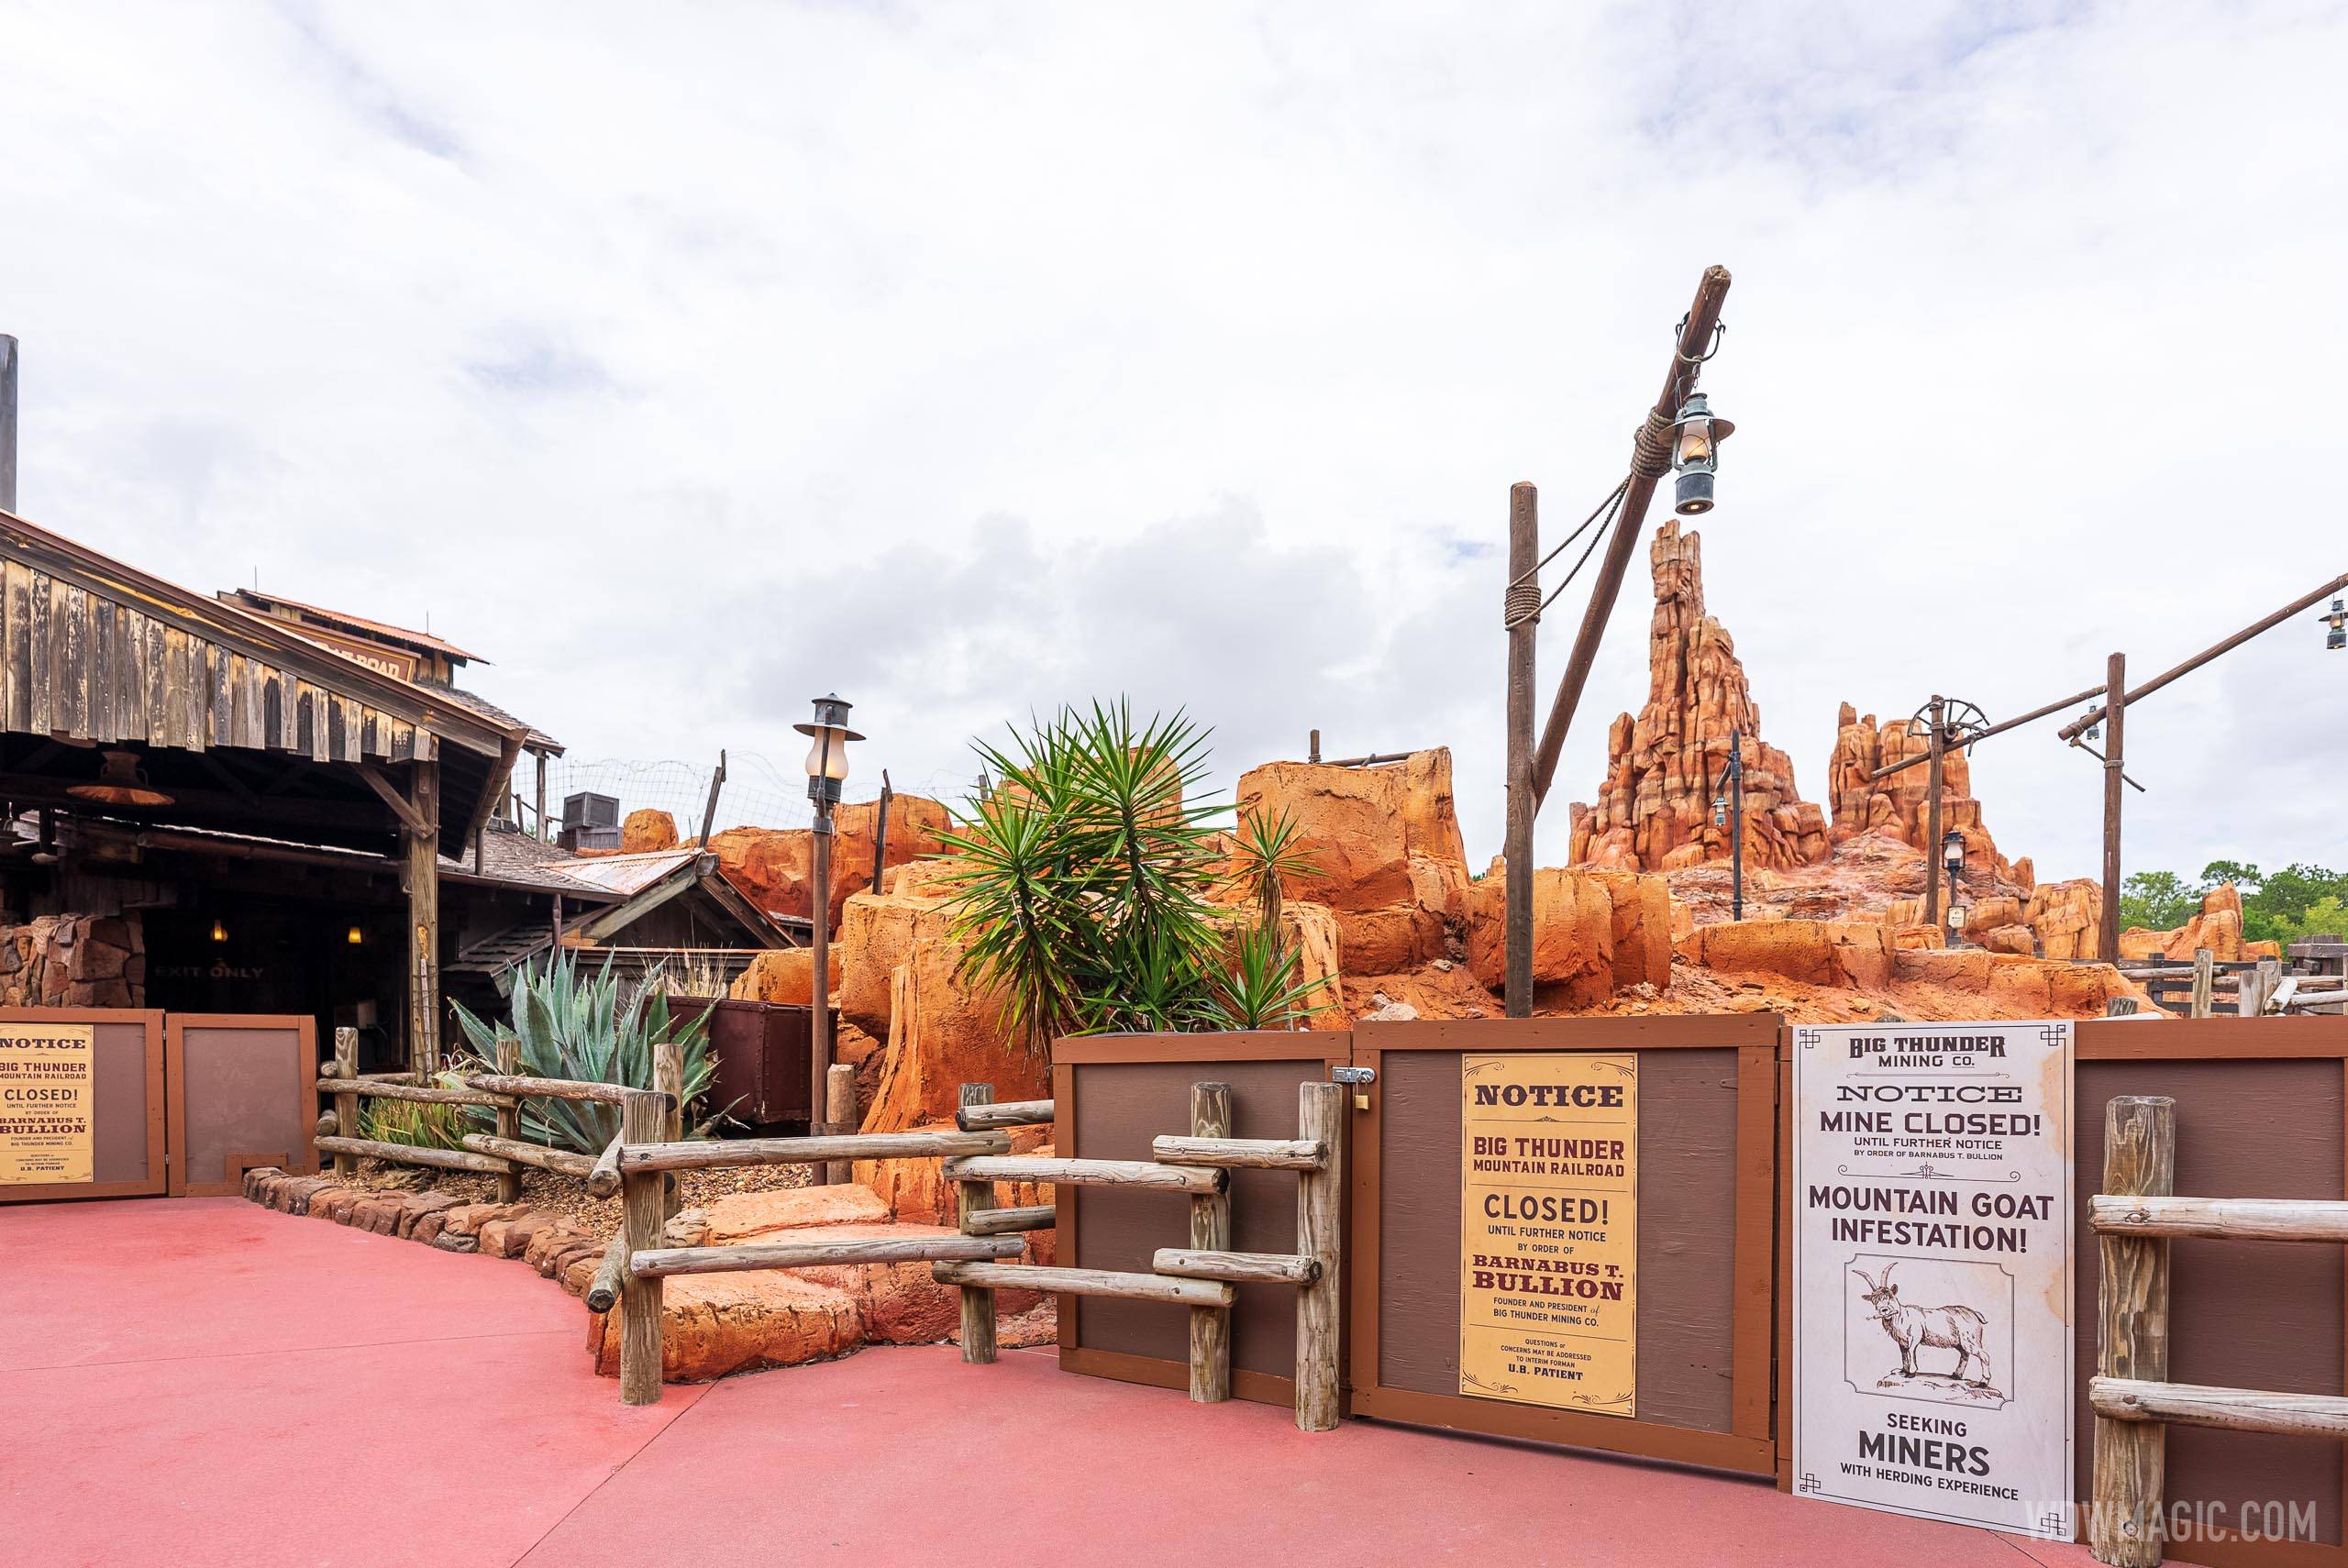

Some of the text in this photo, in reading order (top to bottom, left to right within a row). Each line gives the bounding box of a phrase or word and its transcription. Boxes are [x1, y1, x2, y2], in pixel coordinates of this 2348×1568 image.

[155, 966, 264, 977] EXIT ONLY
[0, 1038, 85, 1049] NOTICE
[1849, 1035, 2007, 1059] BIG THUNDER
[0, 1063, 86, 1072] BIG THUNDER
[1878, 1055, 1975, 1067] MINING CO.
[5, 1088, 78, 1100] CLOSED!
[1475, 1085, 1623, 1108] NOTICE
[1836, 1086, 2022, 1103] NOTICE
[0, 1124, 86, 1133] BULLION
[1820, 1110, 2041, 1136] MINE CLOSED!
[1474, 1136, 1624, 1160] BIG THUNDER
[1854, 1137, 2002, 1150] UNTIL FURTHER NOTICE
[1909, 1151, 1955, 1159] BARNABUS
[1966, 1153, 2003, 1161] BULLION
[1473, 1159, 1624, 1177] MOUNTAIN RAILROAD
[1484, 1194, 1609, 1225] CLOSED!
[1809, 1185, 2054, 1220] MOUNTAIN GOAT
[1488, 1225, 1606, 1242] UNTIL FURTHER NOTICE
[1832, 1217, 2027, 1253] INFESTATION!
[1532, 1244, 1559, 1253] ORDER
[1563, 1246, 1574, 1254] OF
[1472, 1254, 1624, 1278] BARNABUS T.
[1472, 1270, 1624, 1301] BULLION
[1493, 1297, 1600, 1317] FOUNDER AND PRESIDENT of
[1493, 1309, 1600, 1327] BIG THUNDER MINING CO.
[1501, 1344, 1532, 1354] CONCERNS
[1525, 1339, 1558, 1348] QUESTIONS
[1525, 1357, 1548, 1365] INTERIM
[1508, 1364, 1583, 1380] U.B. PATIENT
[1887, 1413, 1967, 1438] SEEKING
[1859, 1430, 1990, 1477] MINERS
[1840, 1462, 2019, 1501] WITH HERDING EXPERIENCE
